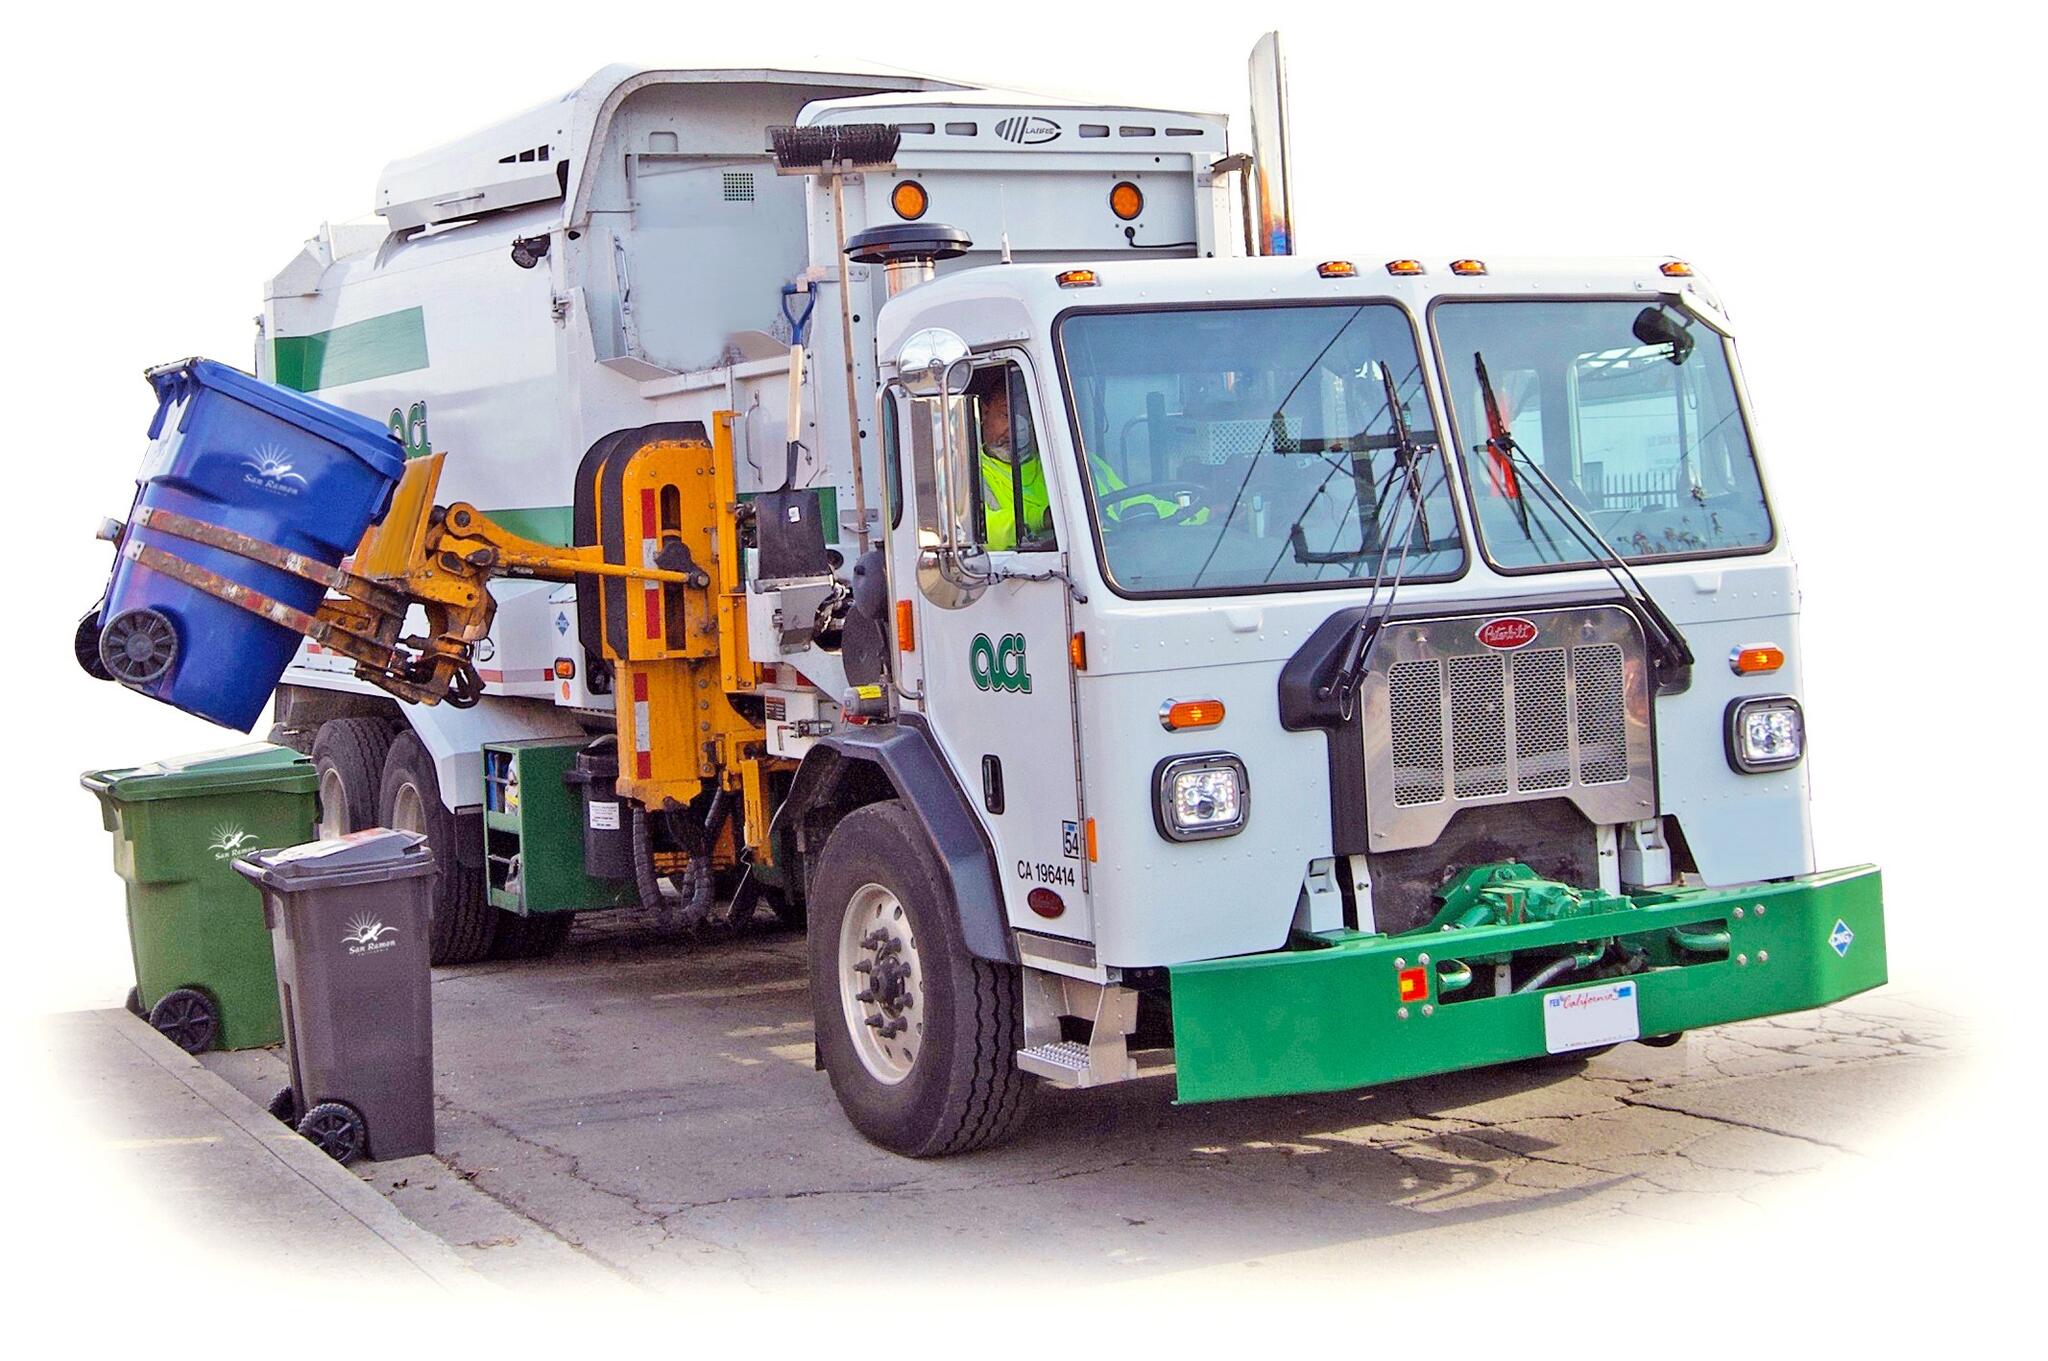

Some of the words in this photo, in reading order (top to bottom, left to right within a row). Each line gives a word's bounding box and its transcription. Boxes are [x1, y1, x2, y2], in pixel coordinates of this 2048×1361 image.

[1065, 831, 1079, 855] 54
[215, 851, 230, 860] San
[231, 846, 256, 857] Ramon
[1017, 860, 1033, 881] CA
[1035, 862, 1076, 887] 196414
[349, 945, 366, 955] San
[367, 940, 396, 951] Ramon
[1562, 992, 1613, 1010] California
